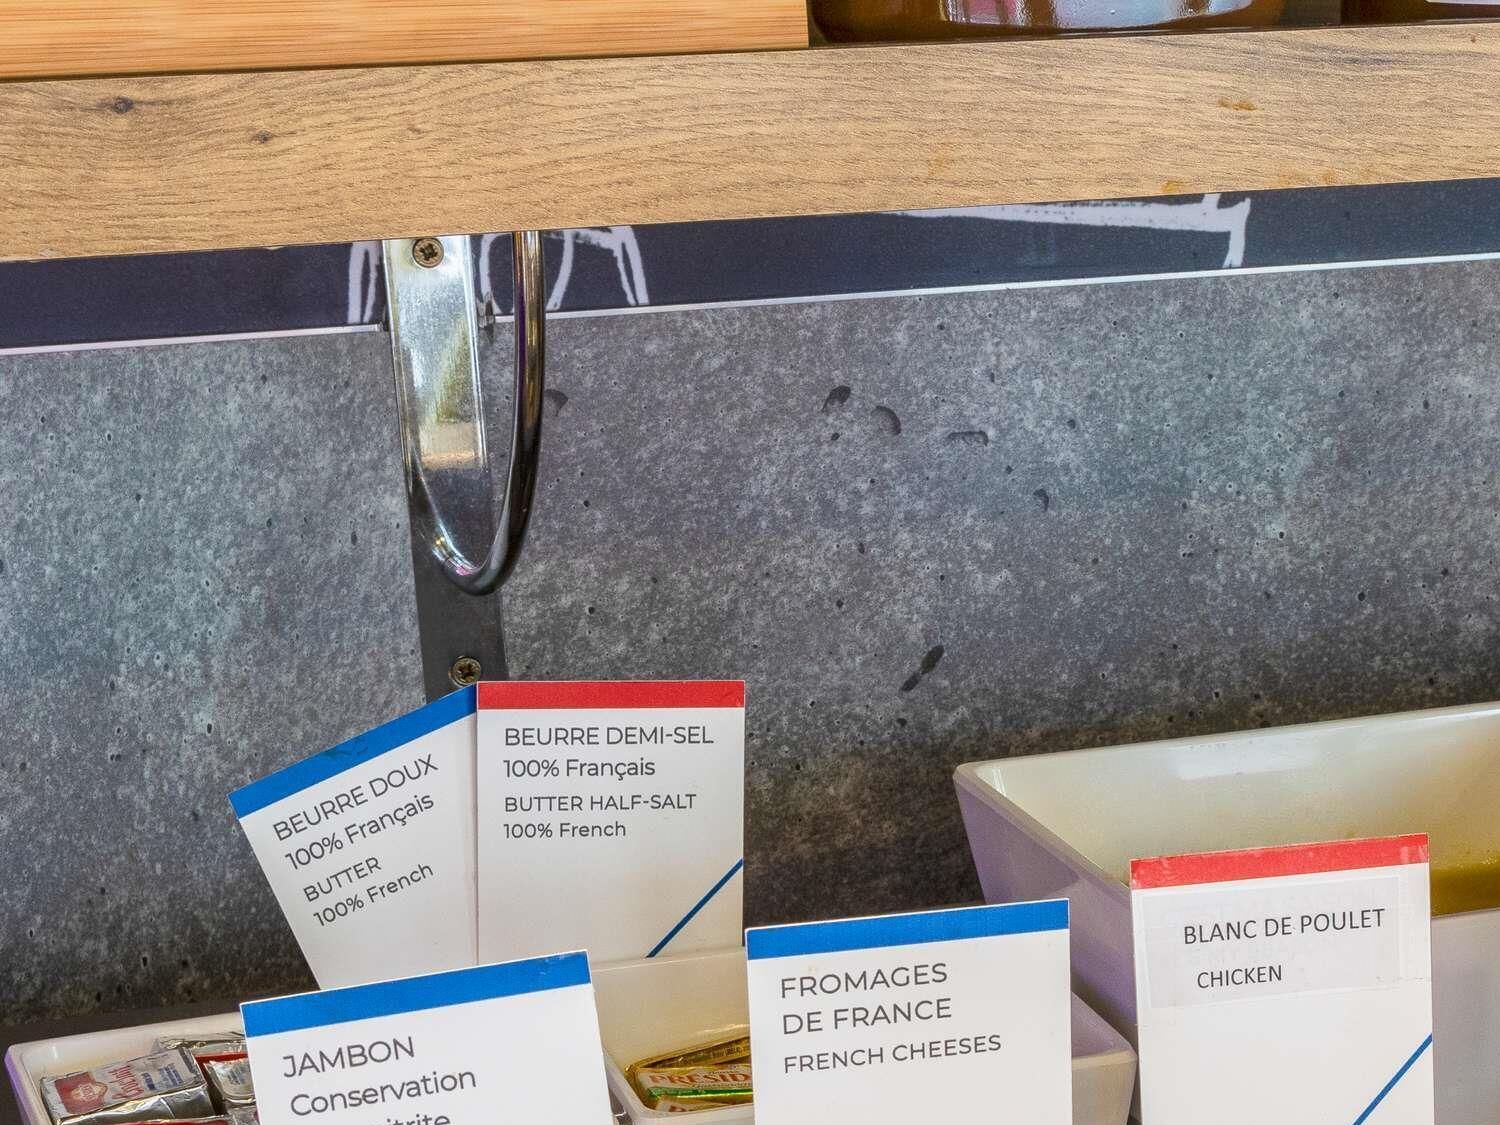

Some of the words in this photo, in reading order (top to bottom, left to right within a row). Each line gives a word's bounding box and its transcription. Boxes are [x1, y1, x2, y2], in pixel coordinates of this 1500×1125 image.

[504, 728, 600, 746] BEURRE
[606, 726, 714, 745] DEMI-SEL
[503, 759, 559, 778] 100%
[566, 758, 655, 782] Français
[273, 786, 367, 842] BEURRE
[370, 754, 439, 799] DOUX
[504, 797, 583, 812] BUTTER
[590, 794, 697, 811] HALF-SALT
[285, 834, 344, 871] 100%
[345, 792, 435, 846] Français
[503, 823, 552, 839] 100%
[559, 821, 626, 838] French
[303, 856, 383, 903] BUTTER
[313, 895, 364, 928] 100%
[367, 862, 434, 903] French
[1184, 920, 1257, 944] BLANC
[1264, 917, 1292, 937] DE
[1300, 909, 1386, 933] POULET
[781, 962, 948, 998] FROMAGES
[1197, 965, 1282, 989] CHICKEN
[783, 1011, 823, 1035] DE
[833, 998, 951, 1030] FRANCE
[283, 1036, 415, 1079] JAMBON
[784, 1047, 883, 1073] FRENCH
[892, 1034, 1002, 1061] CHEESES
[291, 1070, 476, 1116] Conservation
